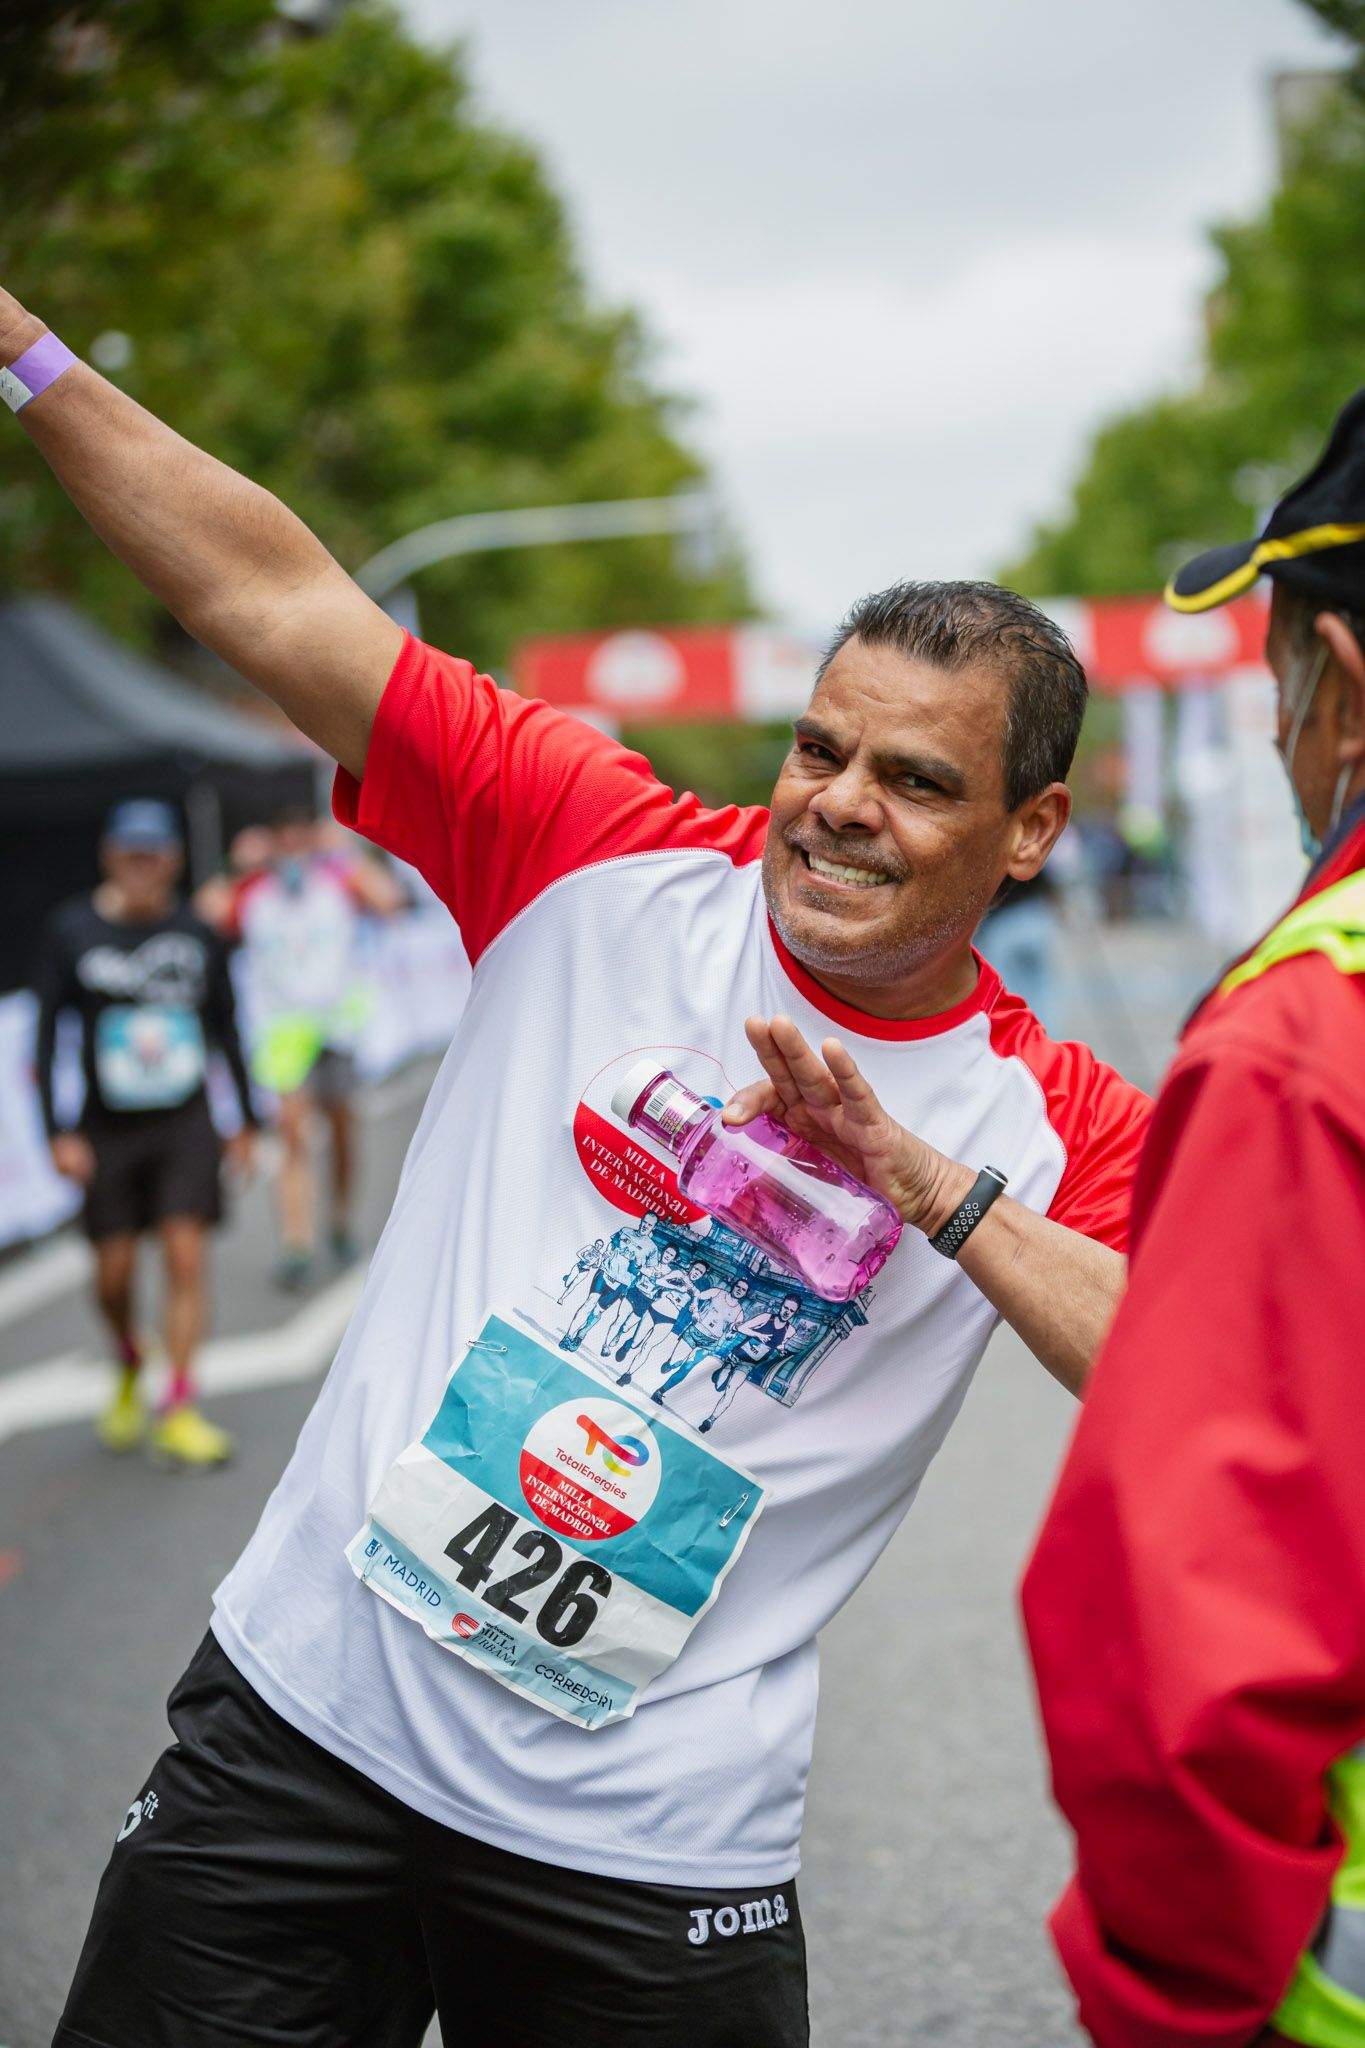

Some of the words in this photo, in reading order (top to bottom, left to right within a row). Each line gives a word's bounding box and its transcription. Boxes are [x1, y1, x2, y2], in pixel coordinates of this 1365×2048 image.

[623, 1146, 666, 1184] MILLA
[590, 1159, 612, 1179] DE
[611, 1174, 666, 1216] MADRID
[555, 1447, 628, 1500] TotalEnergies
[557, 1480, 593, 1509] MILLA
[531, 1493, 548, 1510] DE
[548, 1505, 593, 1536] MADRID
[383, 1554, 441, 1607] MADRID
[443, 1501, 613, 1648] 426
[472, 1635, 517, 1667] URBANA
[480, 1627, 516, 1655] MILLA
[142, 1790, 159, 1819] fit
[687, 1894, 789, 1945] Joma
